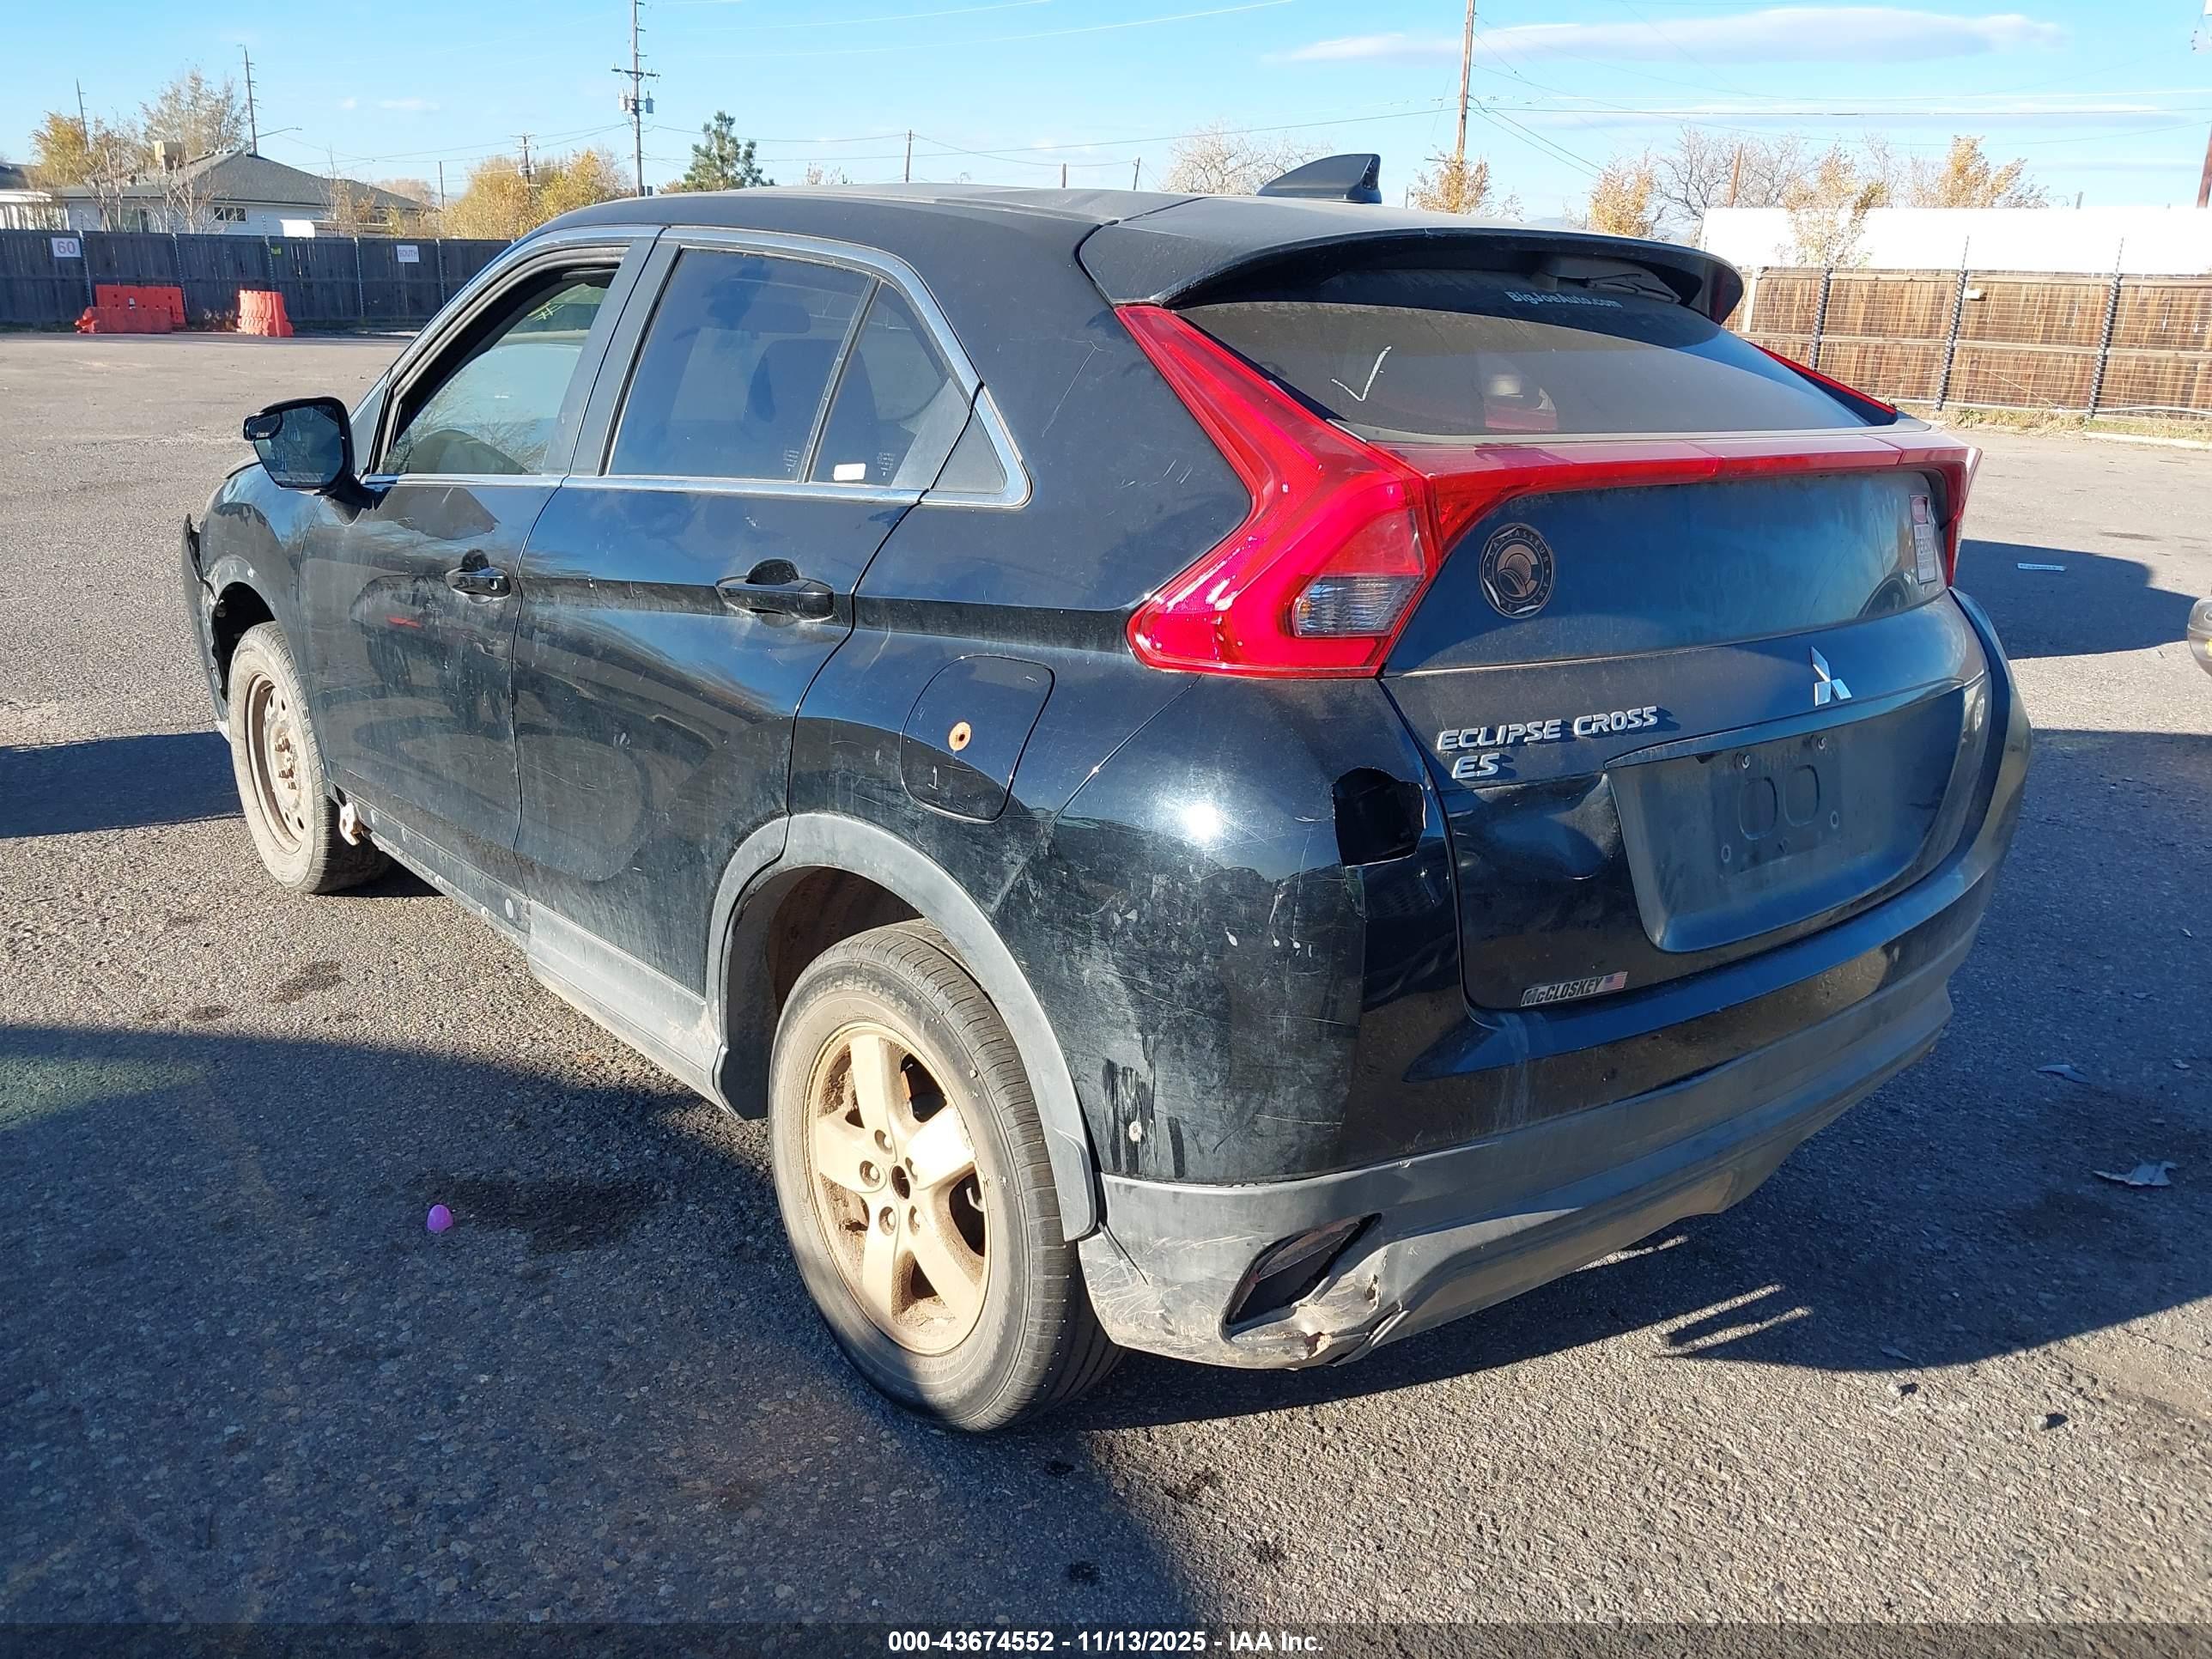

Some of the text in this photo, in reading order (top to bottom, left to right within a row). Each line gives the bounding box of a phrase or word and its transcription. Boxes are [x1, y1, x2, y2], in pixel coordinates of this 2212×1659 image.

[57, 241, 76, 254] 60
[398, 248, 417, 258] SOUTH
[1504, 291, 1623, 308] BigJoeAuto.com
[1437, 705, 1659, 750] ECLIPSE CROSS
[1451, 753, 1500, 780] ES
[1522, 976, 1603, 1005] McCLOSKEY
